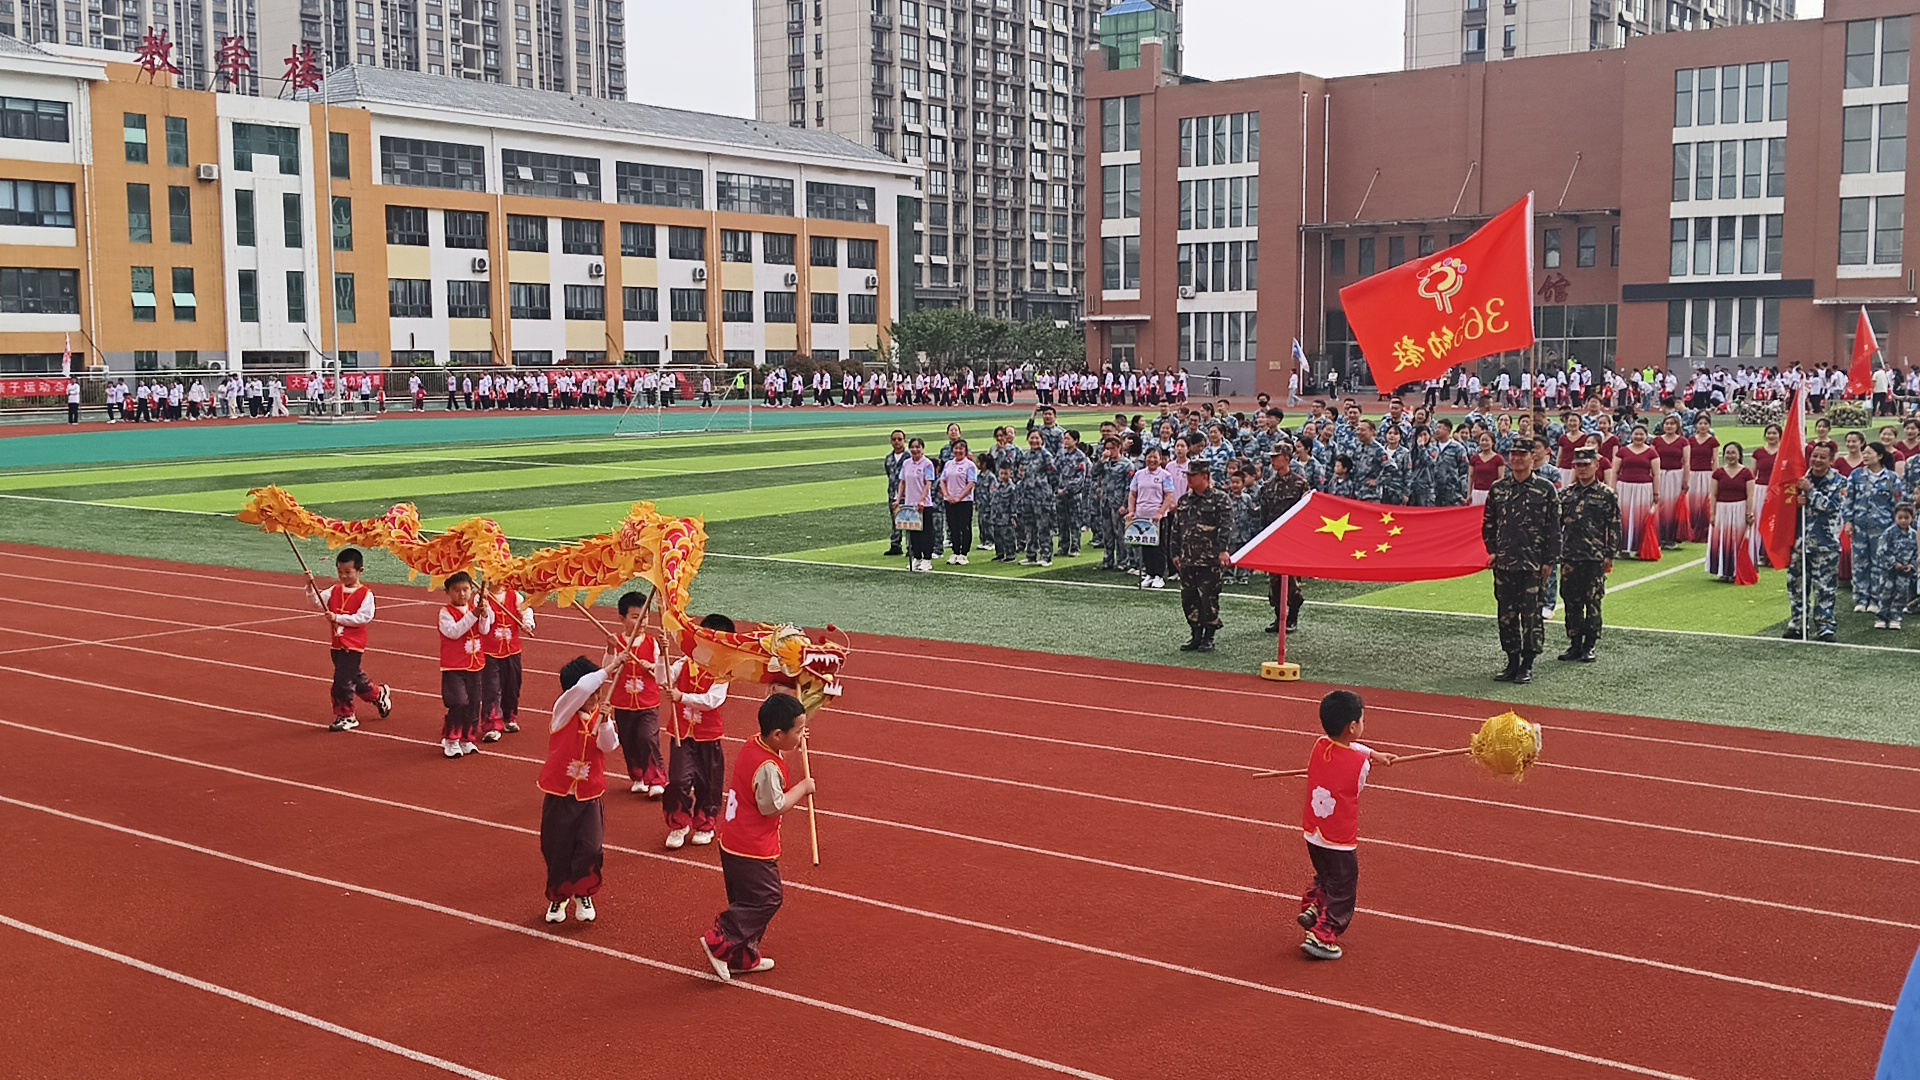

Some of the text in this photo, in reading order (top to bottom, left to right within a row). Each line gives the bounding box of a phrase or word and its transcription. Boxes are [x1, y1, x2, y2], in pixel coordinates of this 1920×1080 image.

[133, 26, 324, 93] 教学楼
[1537, 272, 1571, 303] 馆
